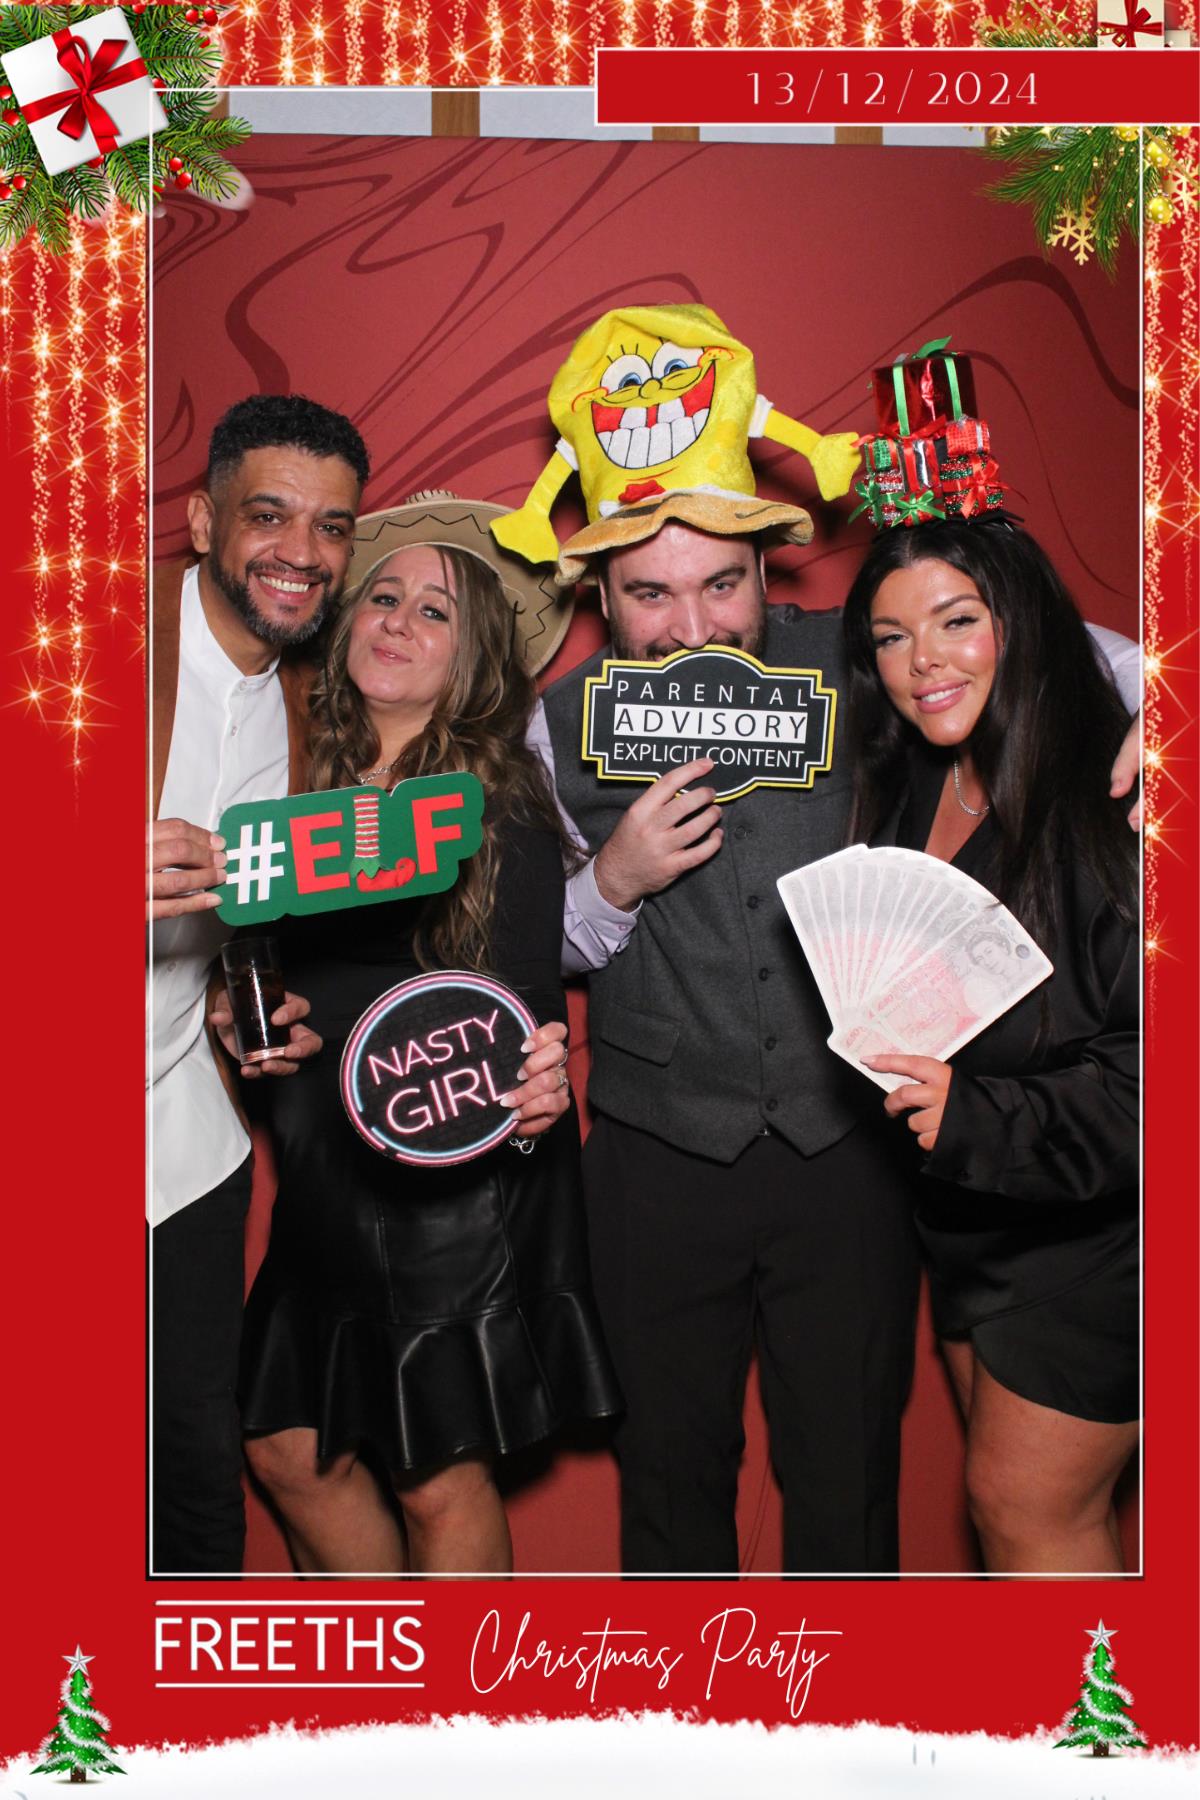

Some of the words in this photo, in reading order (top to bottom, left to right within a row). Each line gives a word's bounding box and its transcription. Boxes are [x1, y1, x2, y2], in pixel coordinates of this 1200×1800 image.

[617, 680, 808, 707] PARENTAL
[614, 707, 807, 739] ADVISORY
[613, 742, 702, 763] EXPLICIT
[705, 746, 805, 768] CONTENT
[367, 1008, 499, 1085] NASTY
[386, 1060, 509, 1134] GIRL
